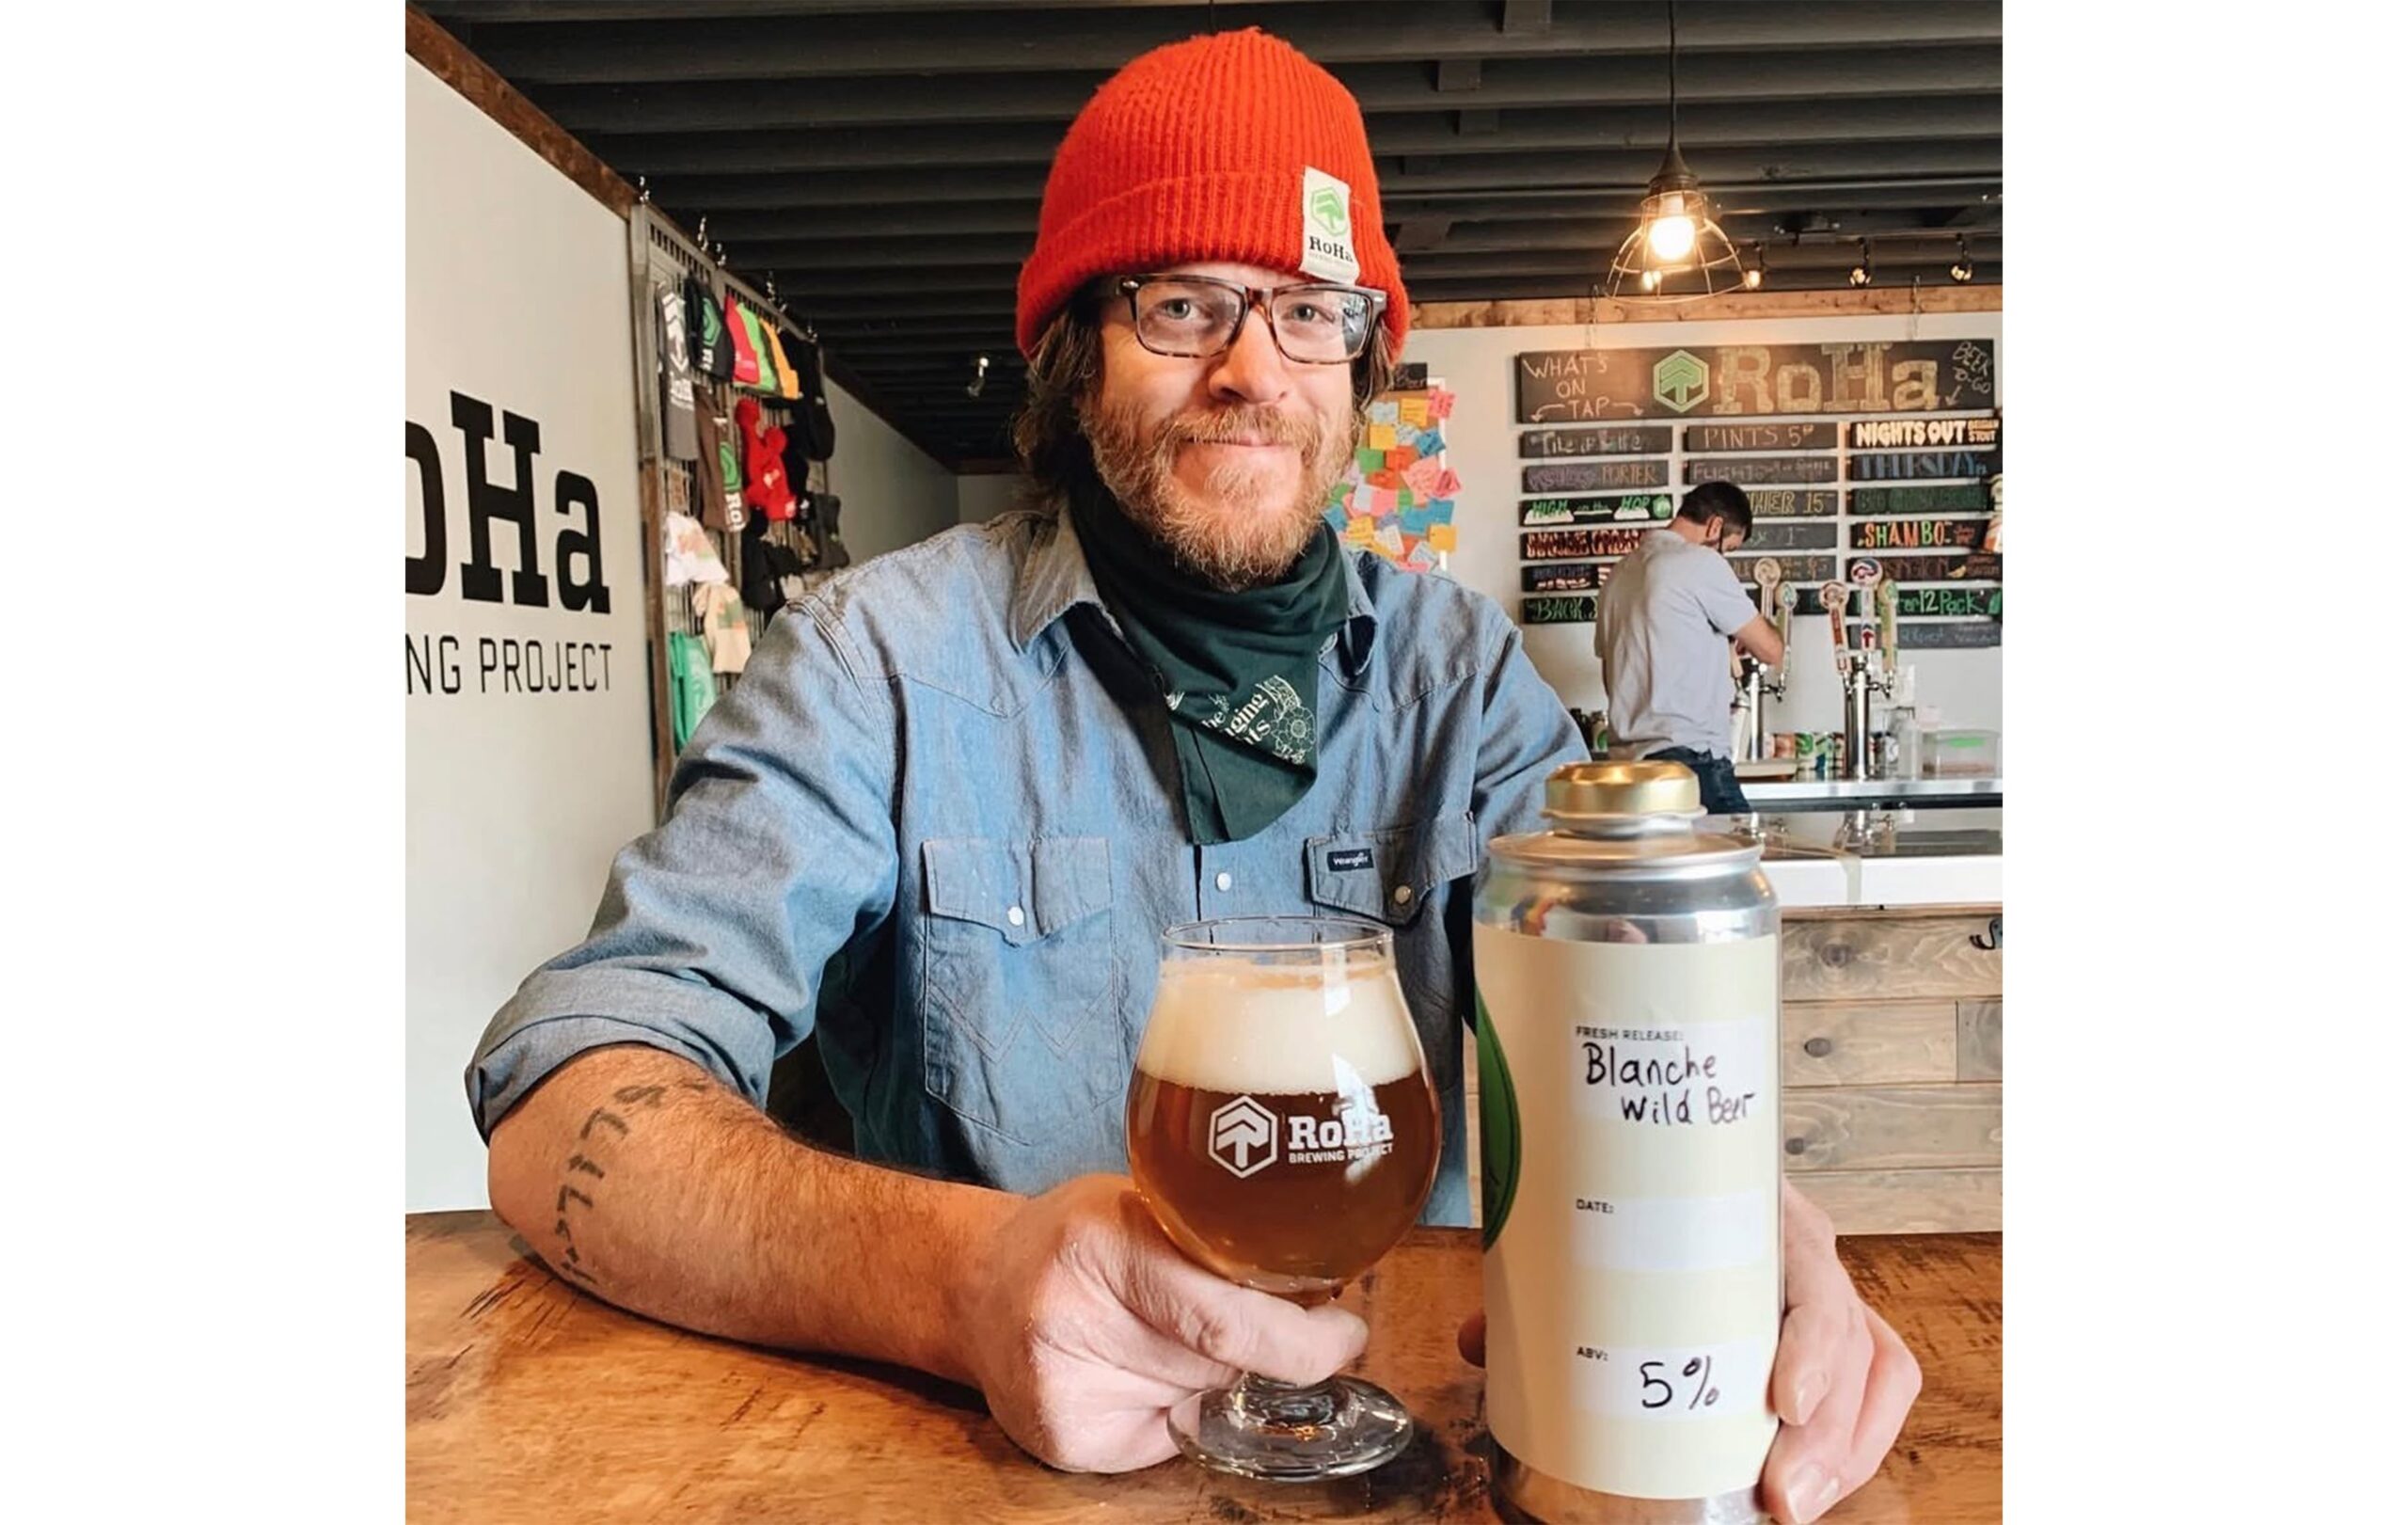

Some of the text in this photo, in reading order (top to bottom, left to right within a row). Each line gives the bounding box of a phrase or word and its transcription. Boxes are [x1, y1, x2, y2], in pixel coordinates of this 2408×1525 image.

[1308, 235, 1354, 262] RoHa
[1556, 378, 1586, 399] ON
[1712, 342, 1941, 415] RoHa
[1568, 396, 1609, 420] TAP
[1704, 426, 1779, 450] PINTS
[1856, 421, 1926, 447] NIGHTS
[1927, 421, 1967, 445] OUT
[1864, 521, 1945, 548] SHAMBO
[479, 637, 612, 693] PROJECT
[1576, 1025, 1618, 1039] FRESH
[1582, 1041, 1717, 1088] Blanche
[1707, 1087, 1755, 1125] Beer
[1288, 1115, 1394, 1151] RoHa
[1289, 1150, 1345, 1165] BREWING
[1576, 1199, 1615, 1215] DATE:
[1576, 1346, 1608, 1361] ABV:
